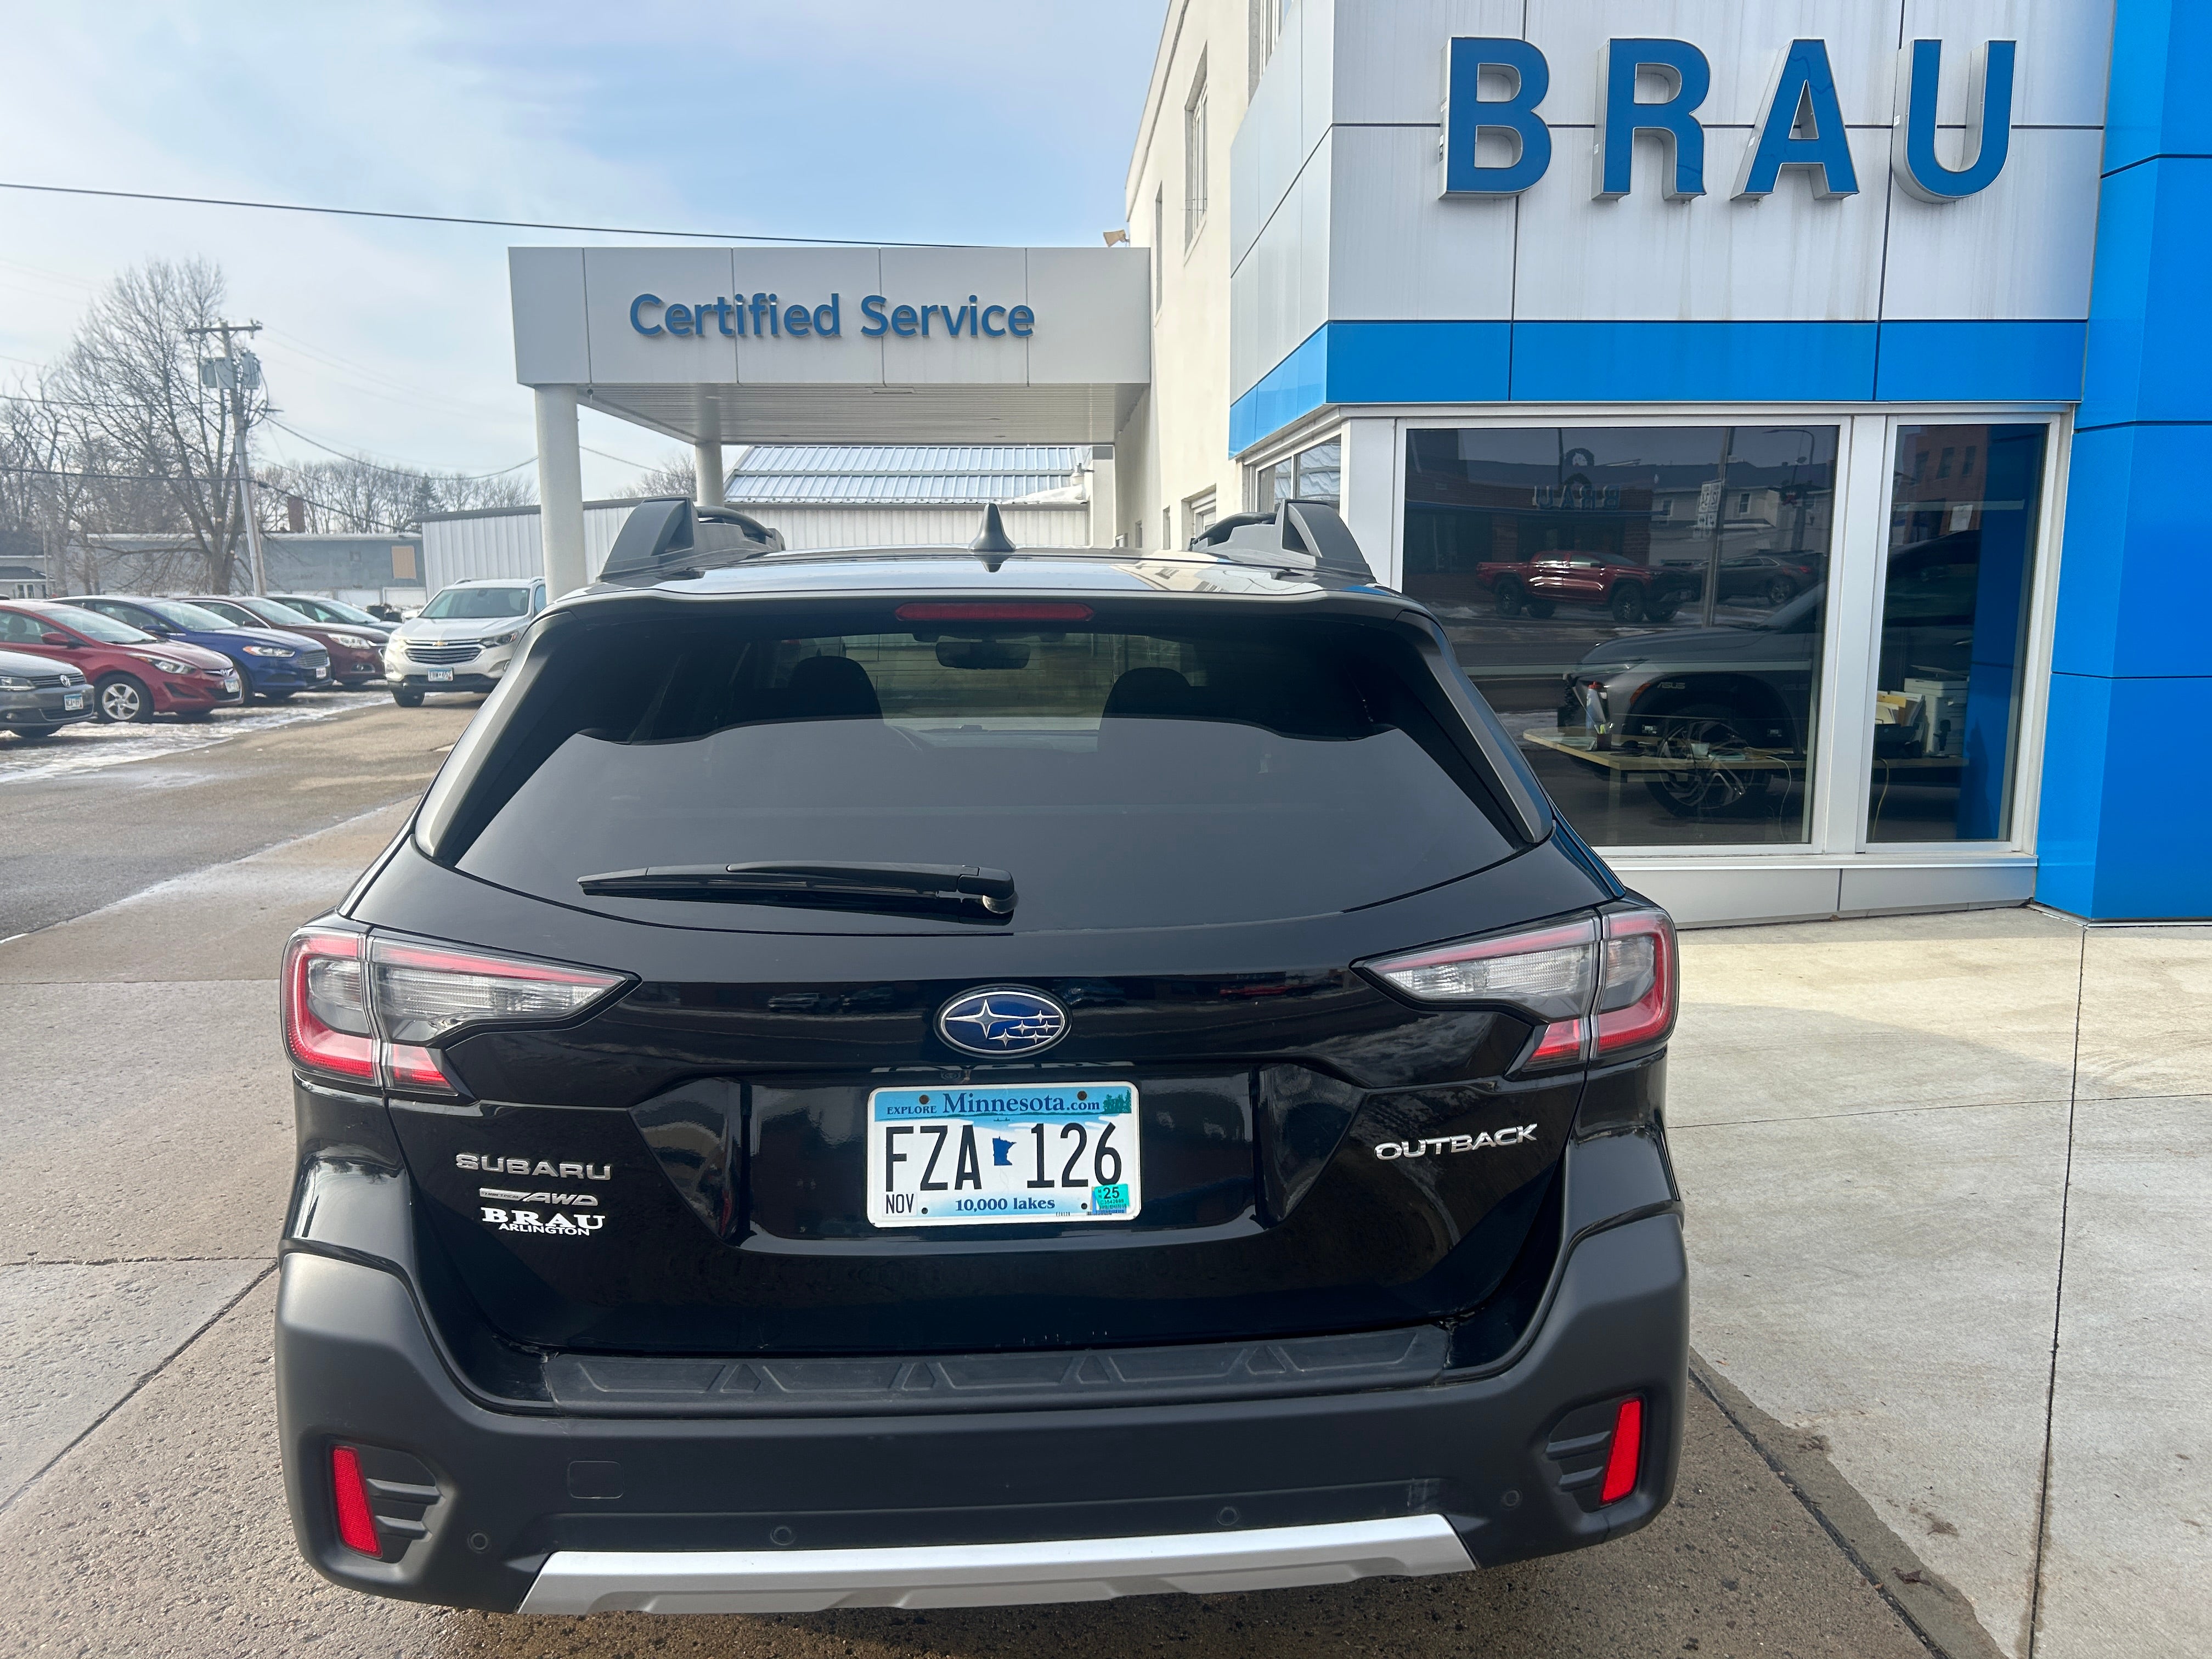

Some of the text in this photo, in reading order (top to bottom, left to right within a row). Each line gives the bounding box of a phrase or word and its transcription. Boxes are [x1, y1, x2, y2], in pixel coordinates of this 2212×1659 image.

[1440, 36, 2017, 203] BRAU
[630, 292, 1035, 338] Certified Service
[1657, 681, 1685, 690] ASUS
[887, 1093, 1101, 1115] EXPLORE Minnesota.com
[1374, 1124, 1538, 1160] OUTBACK
[455, 1153, 612, 1181] SUBARU
[885, 1122, 1122, 1192] FZA 126
[523, 1192, 599, 1206] AWD
[885, 1193, 915, 1214] NOV
[1103, 1186, 1120, 1199] 25
[955, 1197, 1056, 1213] 10,000 lakes
[481, 1206, 606, 1229] BRAU
[498, 1222, 590, 1236] ARLINGTON
